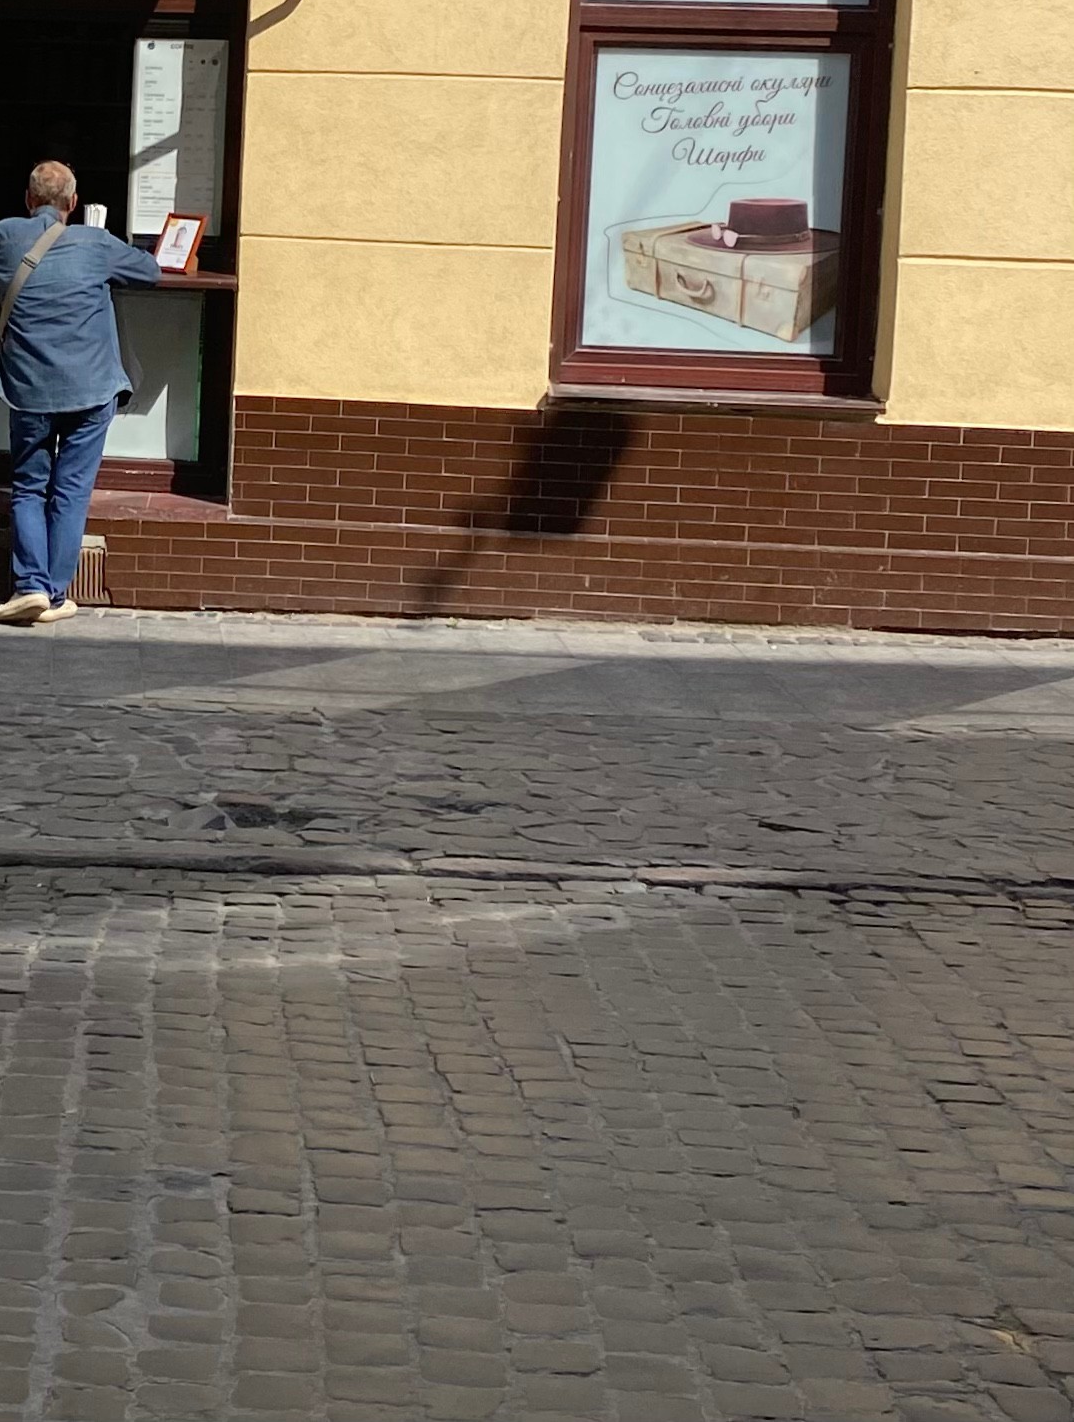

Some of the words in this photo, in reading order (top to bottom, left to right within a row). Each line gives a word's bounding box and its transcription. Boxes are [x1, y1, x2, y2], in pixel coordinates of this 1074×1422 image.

[613, 71, 744, 104] Сонцезахисні
[750, 75, 834, 100] окуляри
[641, 101, 732, 134] Головні
[732, 100, 797, 137] убори
[671, 137, 767, 172] Шарфи
